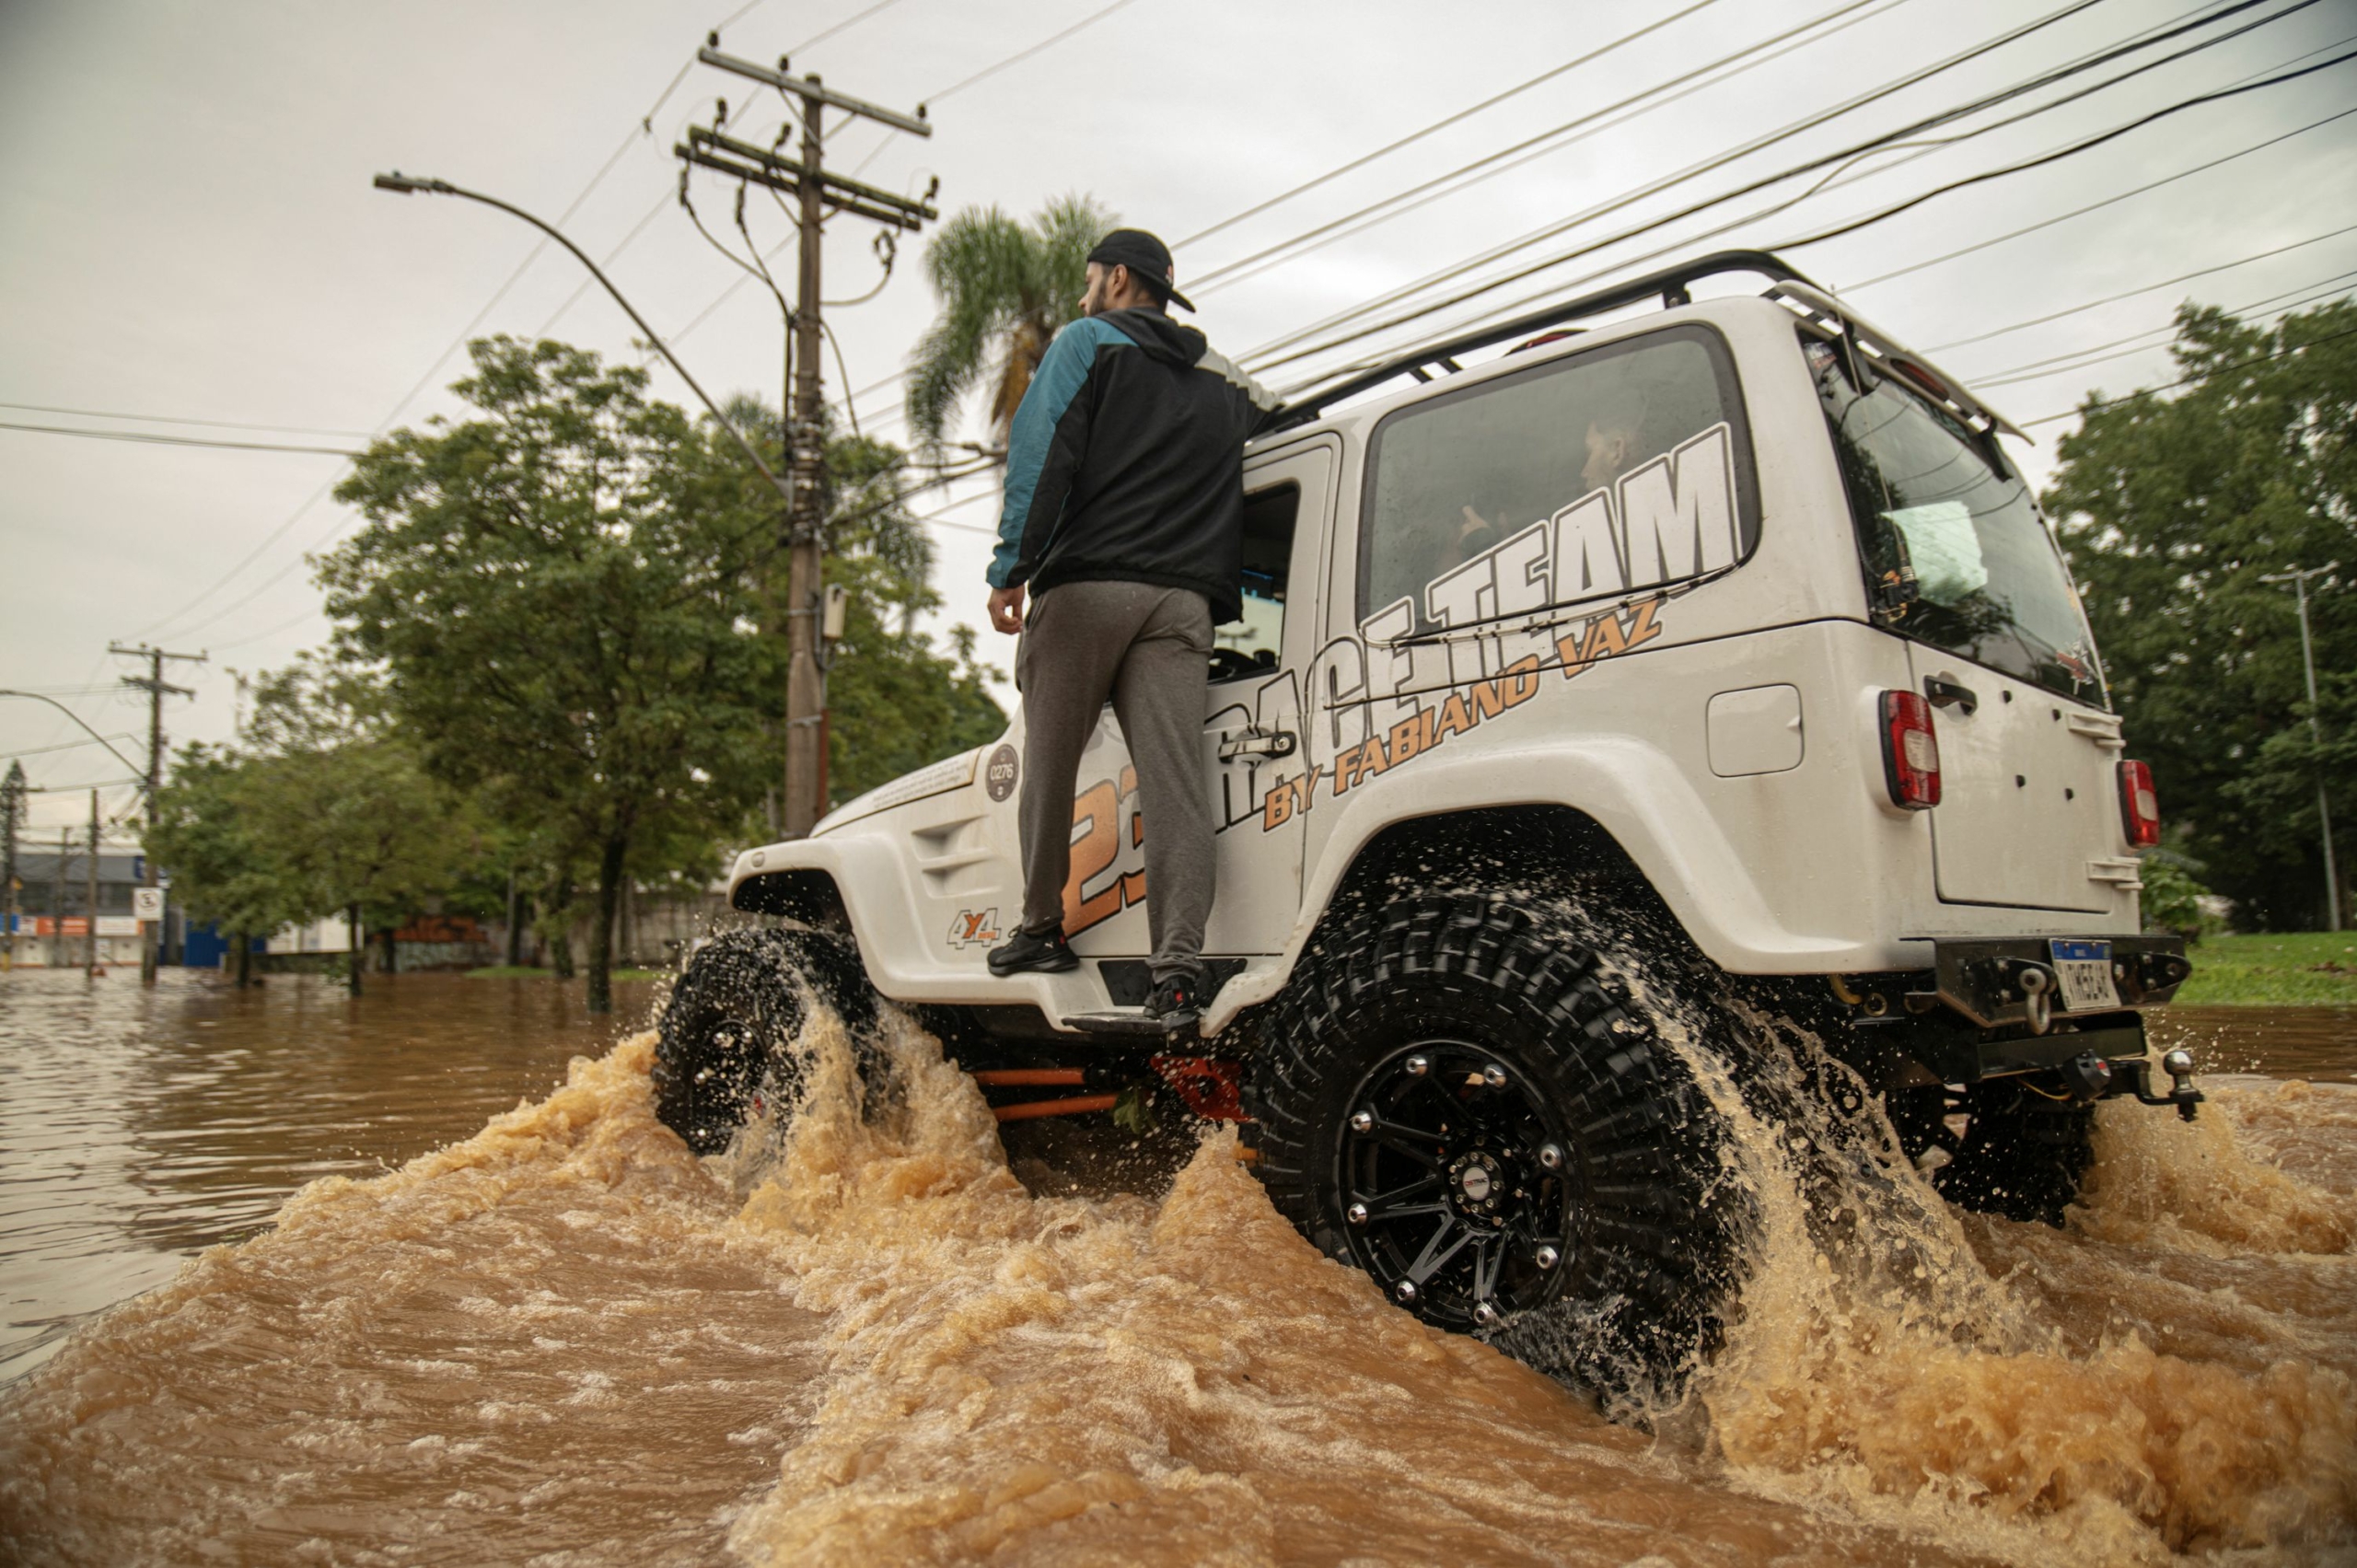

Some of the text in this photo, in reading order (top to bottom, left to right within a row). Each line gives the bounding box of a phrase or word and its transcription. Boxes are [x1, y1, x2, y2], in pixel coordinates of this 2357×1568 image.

[1204, 422, 1742, 834] RACE TEAM
[1263, 597, 1663, 831] BY FABIANO VAZ
[990, 762, 1015, 781] 0276
